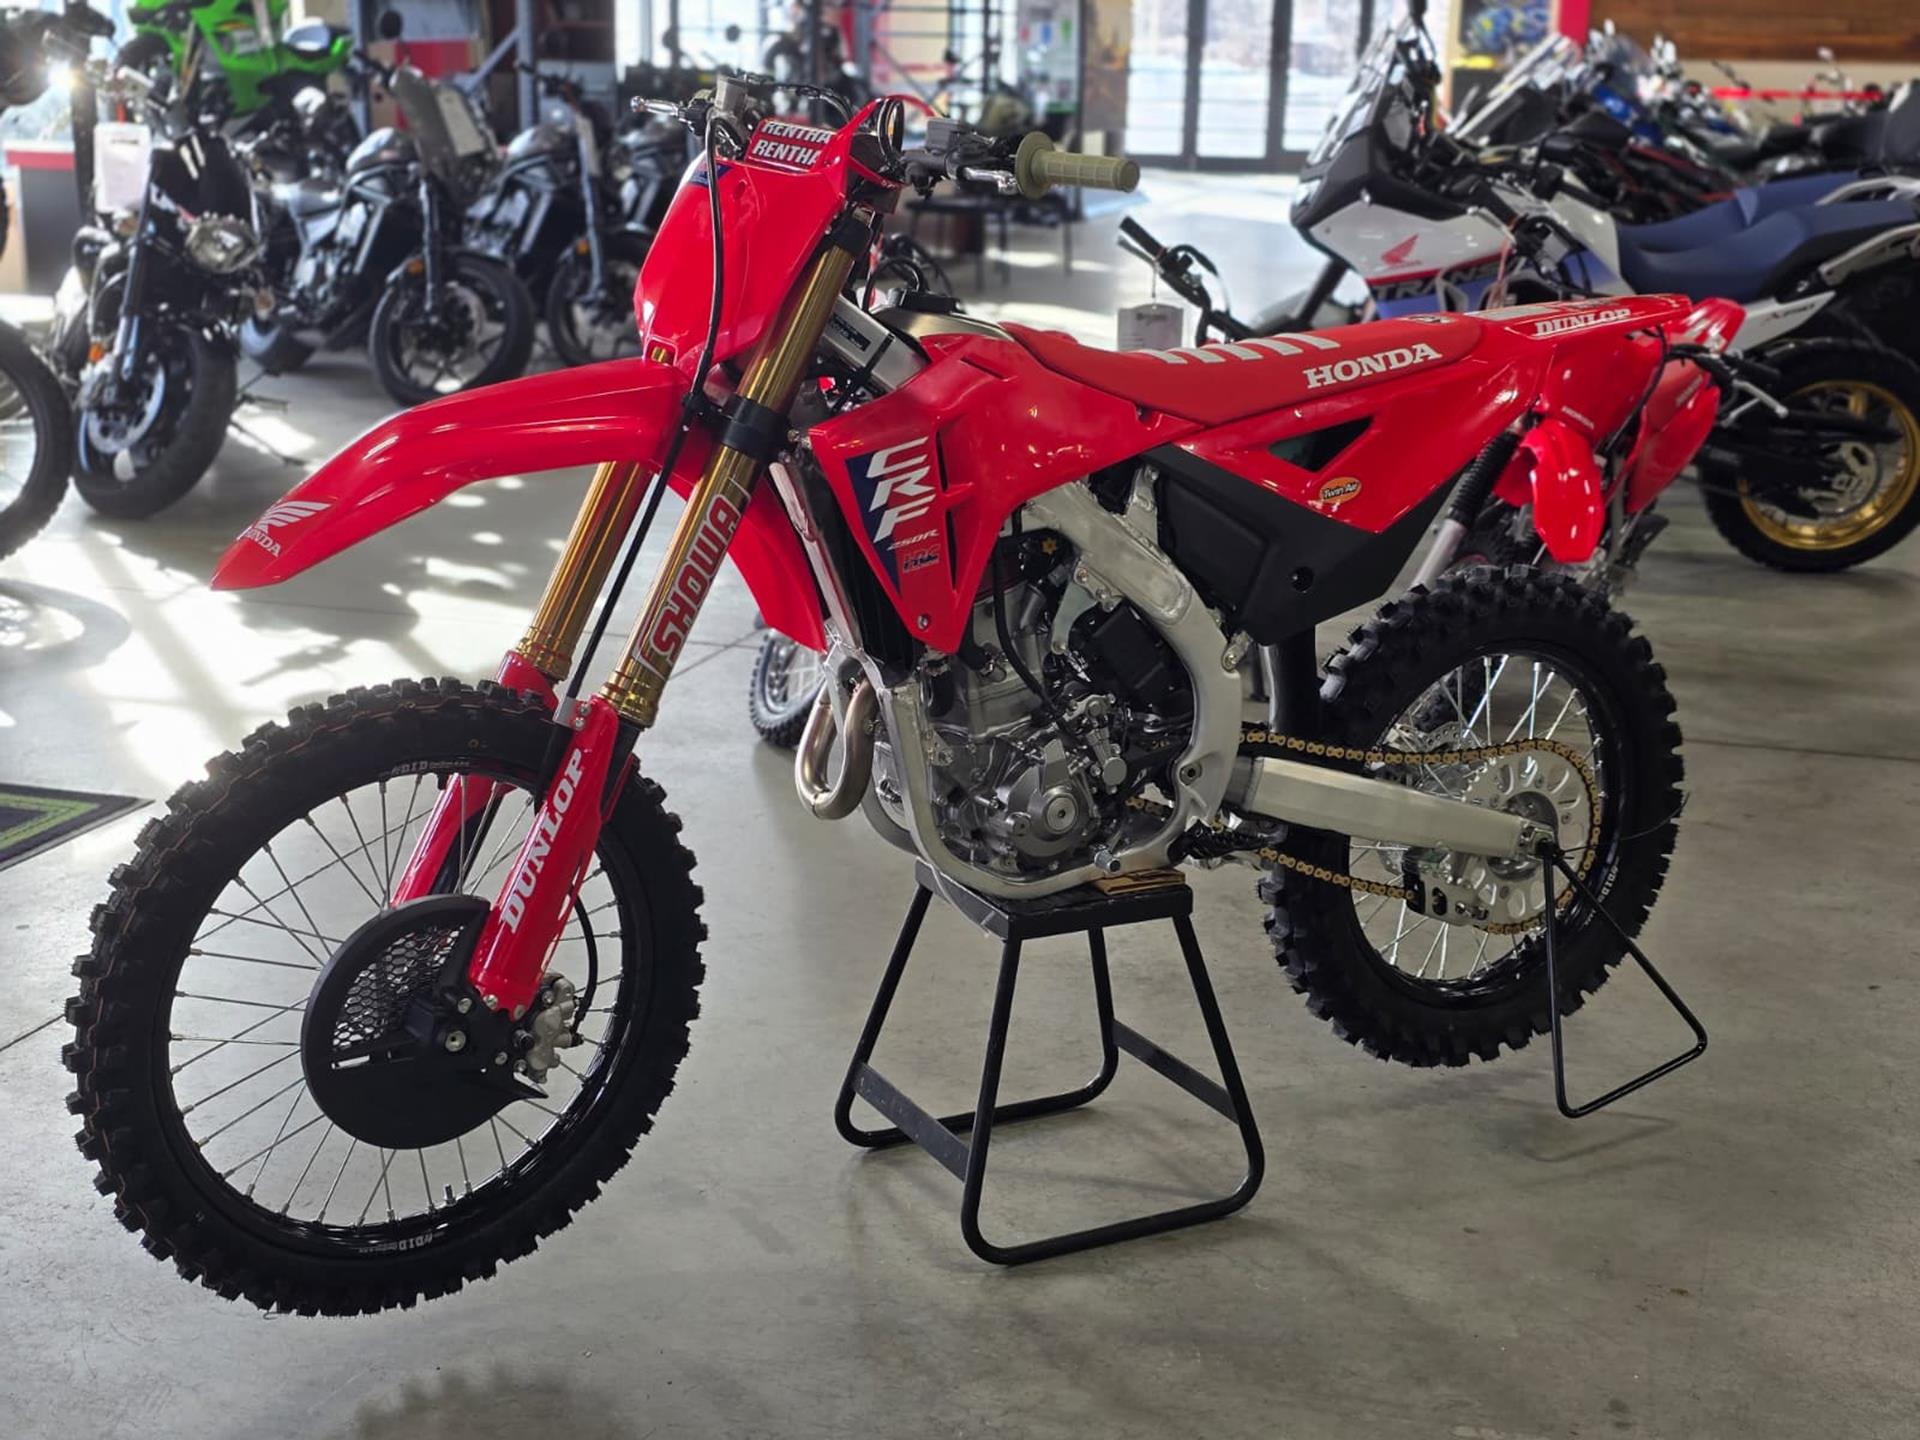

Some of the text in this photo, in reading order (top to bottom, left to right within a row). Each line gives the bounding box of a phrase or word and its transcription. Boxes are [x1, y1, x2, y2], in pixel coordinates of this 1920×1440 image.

[1533, 308, 1632, 337] DUNLOP
[1303, 343, 1442, 389] HONDA
[866, 436, 936, 543] CRF
[1323, 487, 1344, 499] Twin
[886, 529, 940, 551] 250R
[651, 495, 741, 668] SHOWA
[502, 748, 583, 934] DUNLOP
